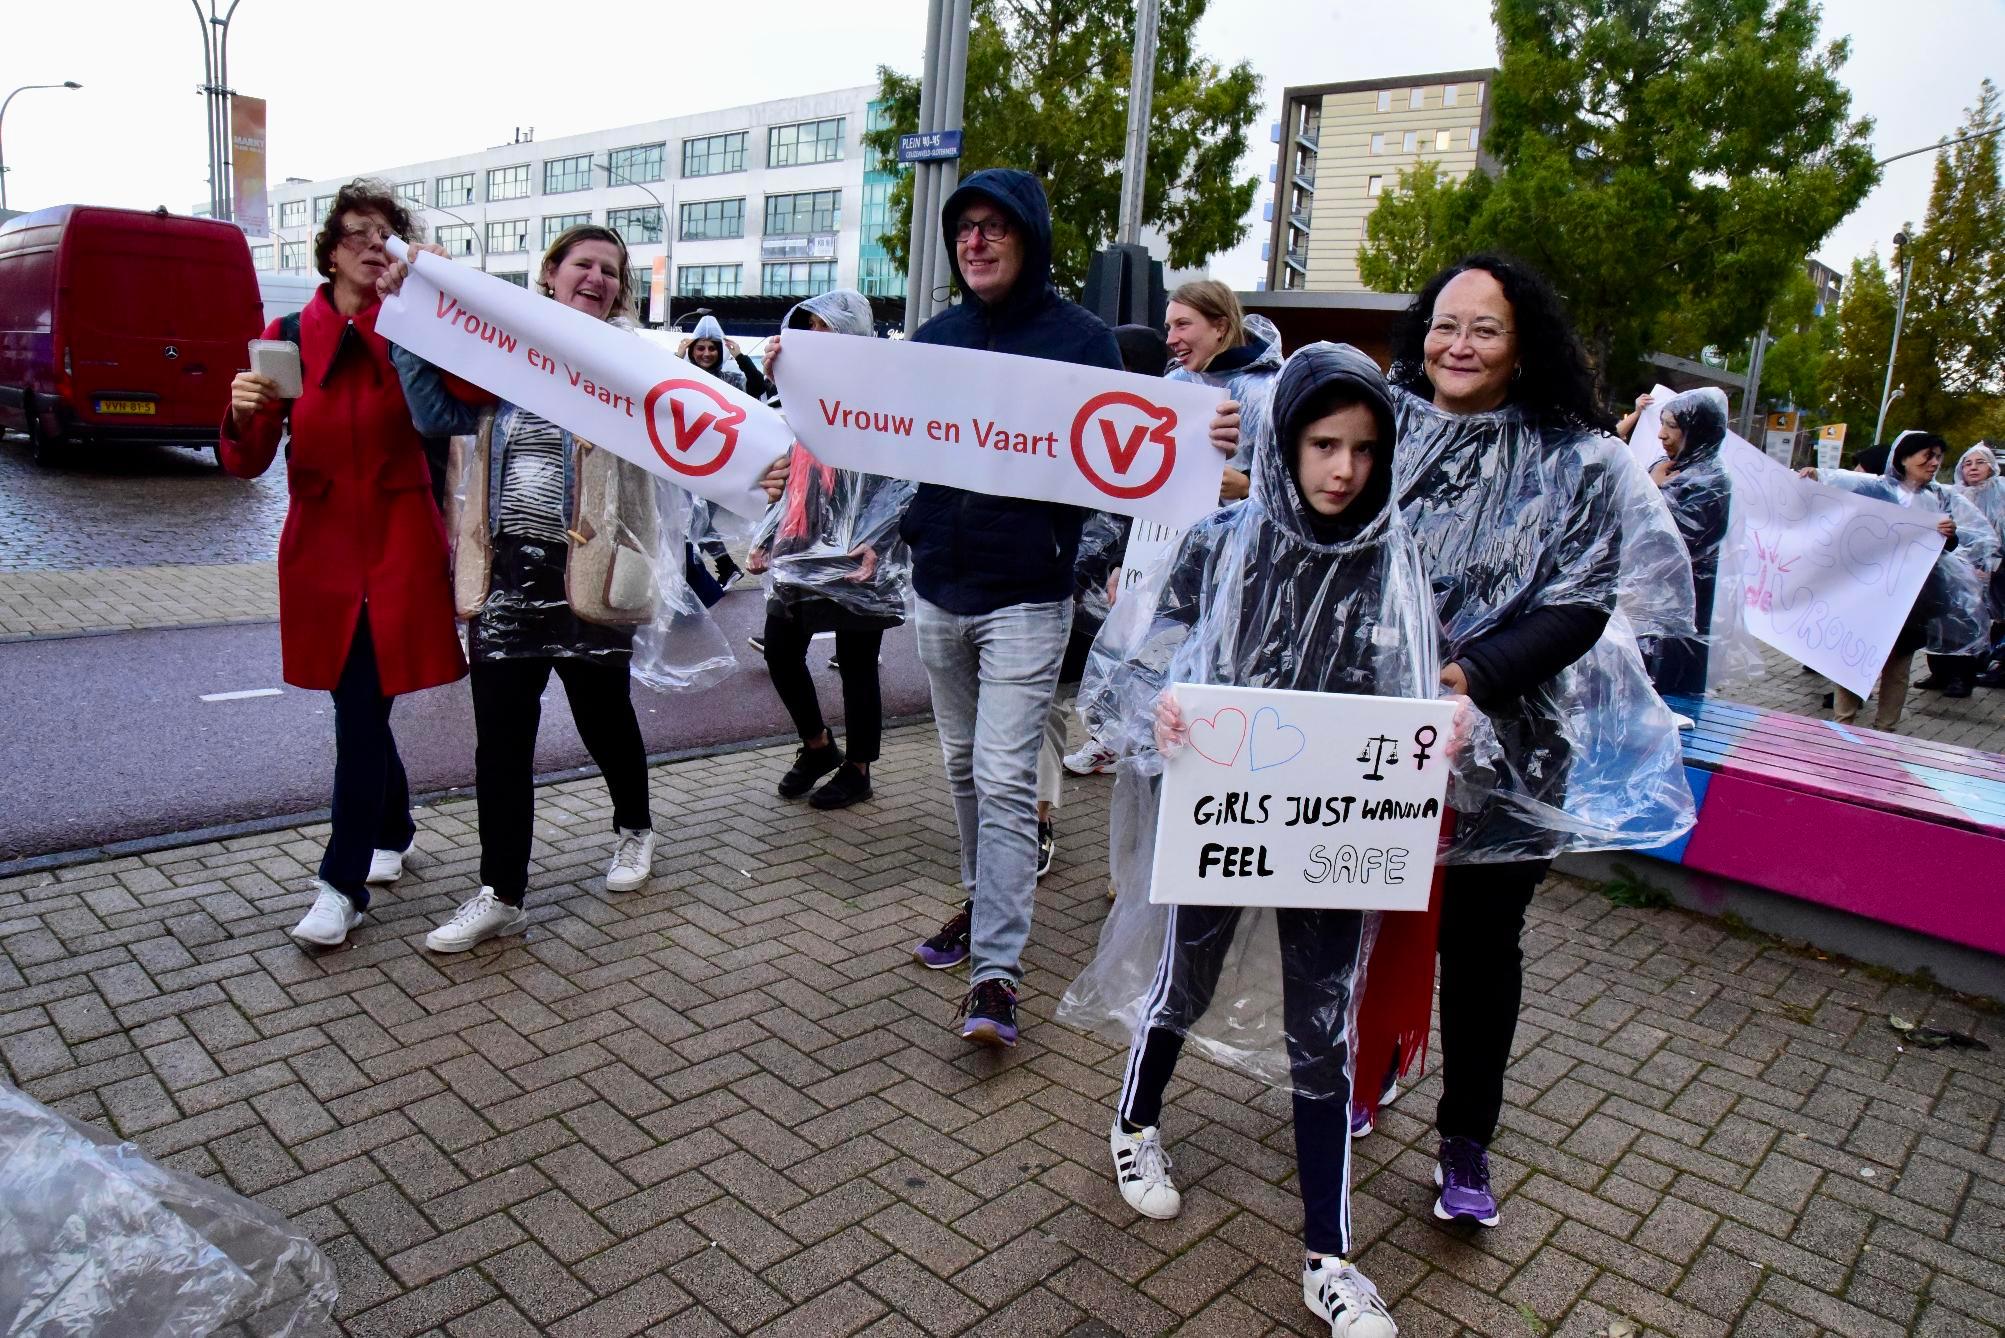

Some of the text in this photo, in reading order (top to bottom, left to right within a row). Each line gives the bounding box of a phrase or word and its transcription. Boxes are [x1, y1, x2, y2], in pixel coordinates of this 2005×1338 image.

[902, 137, 920, 149] PLEIN
[436, 288, 636, 418] Vrouw en Vaart
[818, 398, 1059, 459] Vrouw en Vaart
[1733, 448, 1944, 597] SPECT
[1285, 796, 1356, 827] JUST
[1361, 797, 1438, 821] WANNA
[1198, 843, 1409, 885] FEEL SAFE
